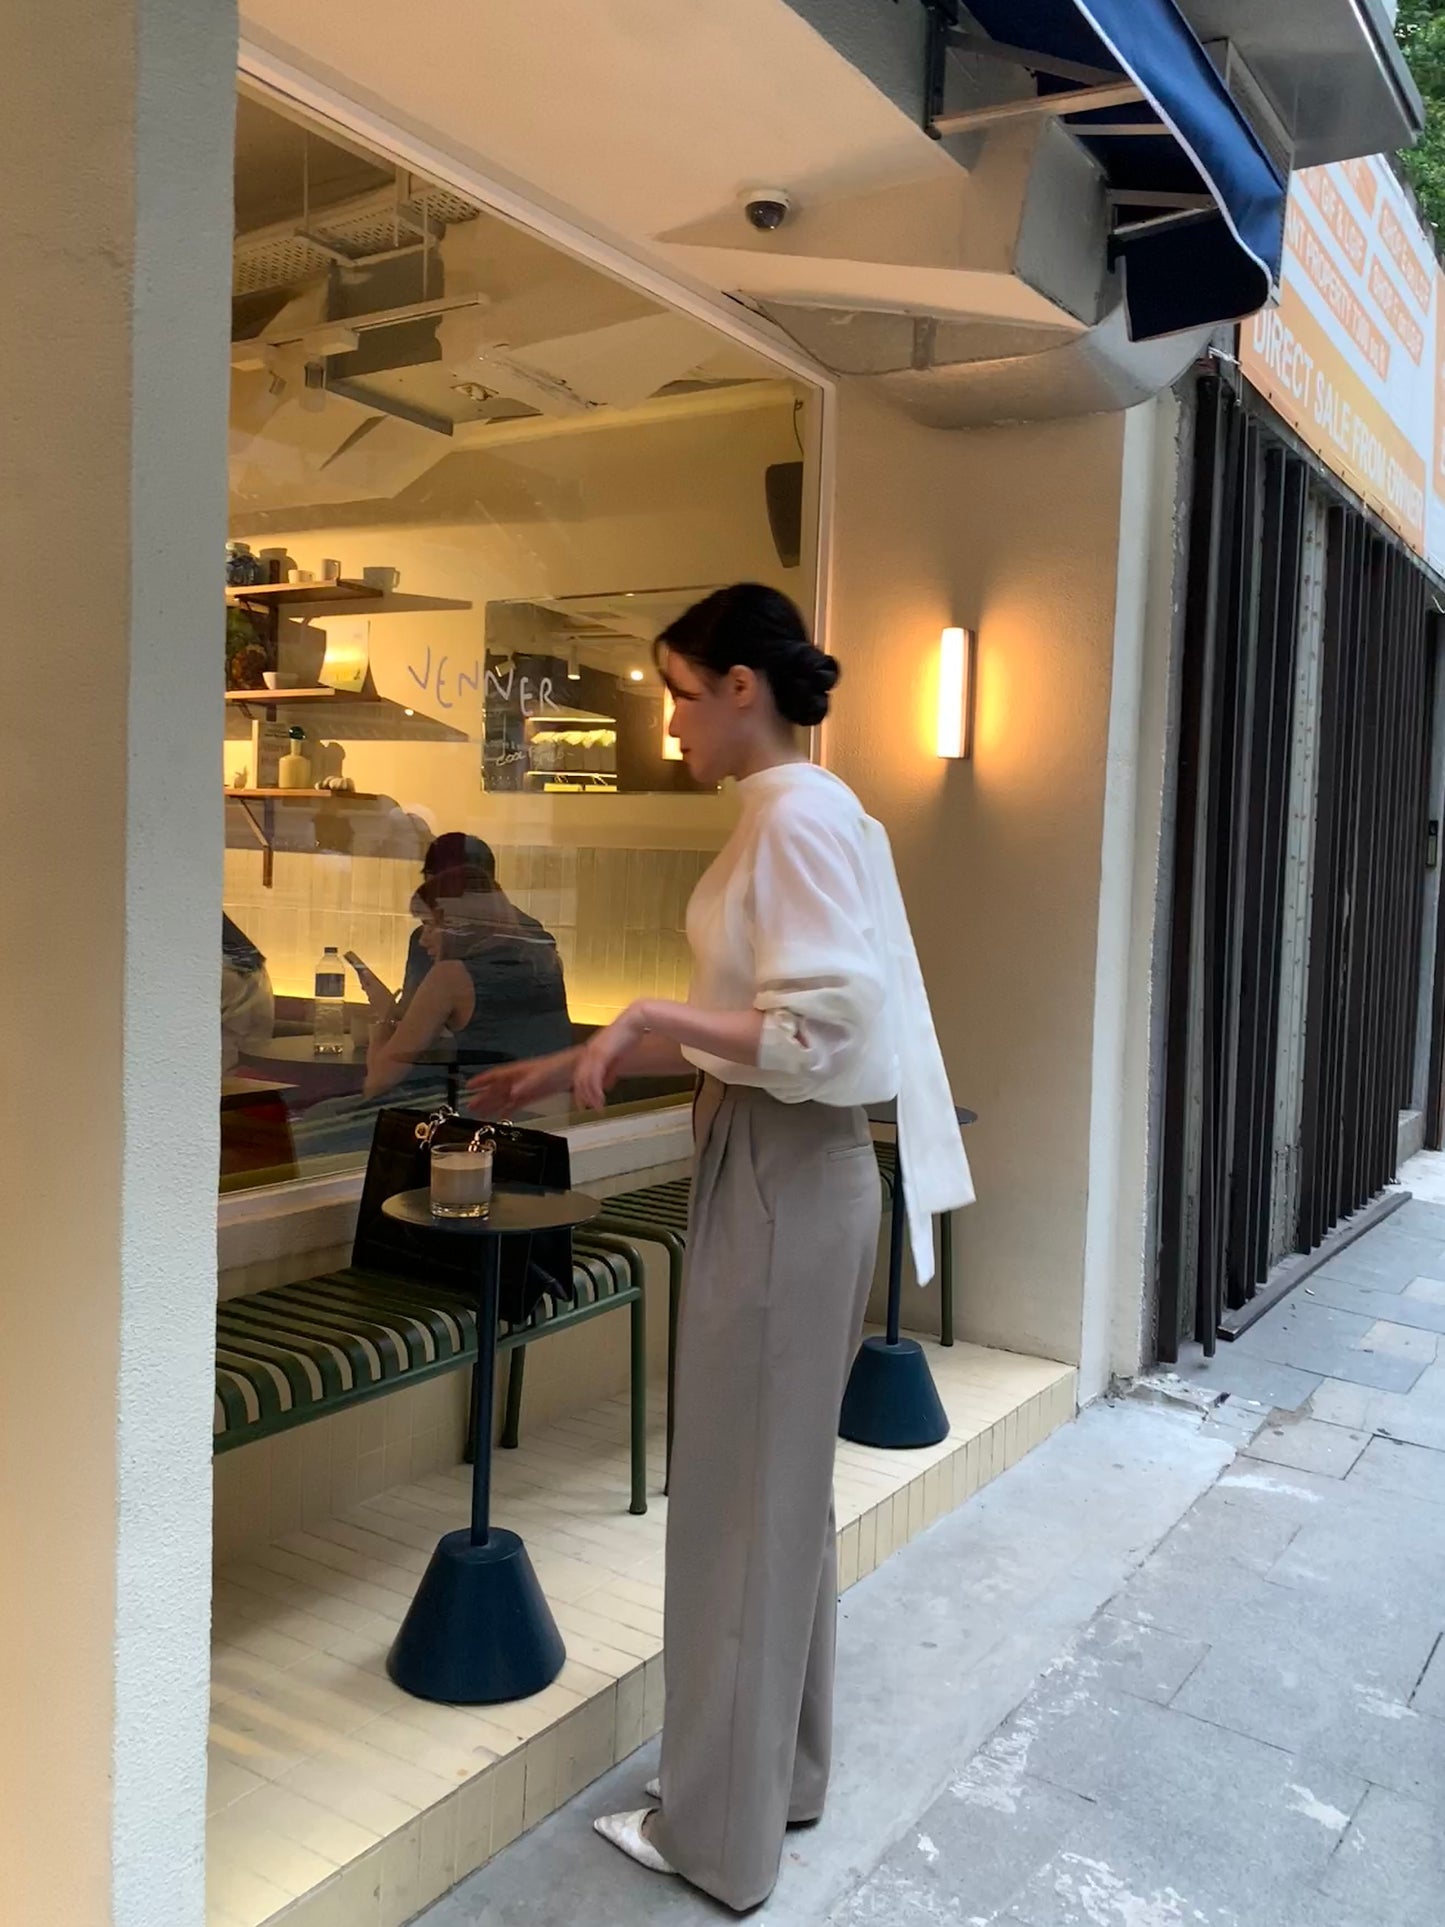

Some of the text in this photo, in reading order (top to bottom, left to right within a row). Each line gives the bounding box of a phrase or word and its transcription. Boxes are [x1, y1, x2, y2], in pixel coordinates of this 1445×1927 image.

[1254, 309, 1314, 408] DIRECT
[1314, 371, 1350, 454] SALE
[1352, 415, 1388, 487] FROM
[408, 646, 560, 717] VENNER
